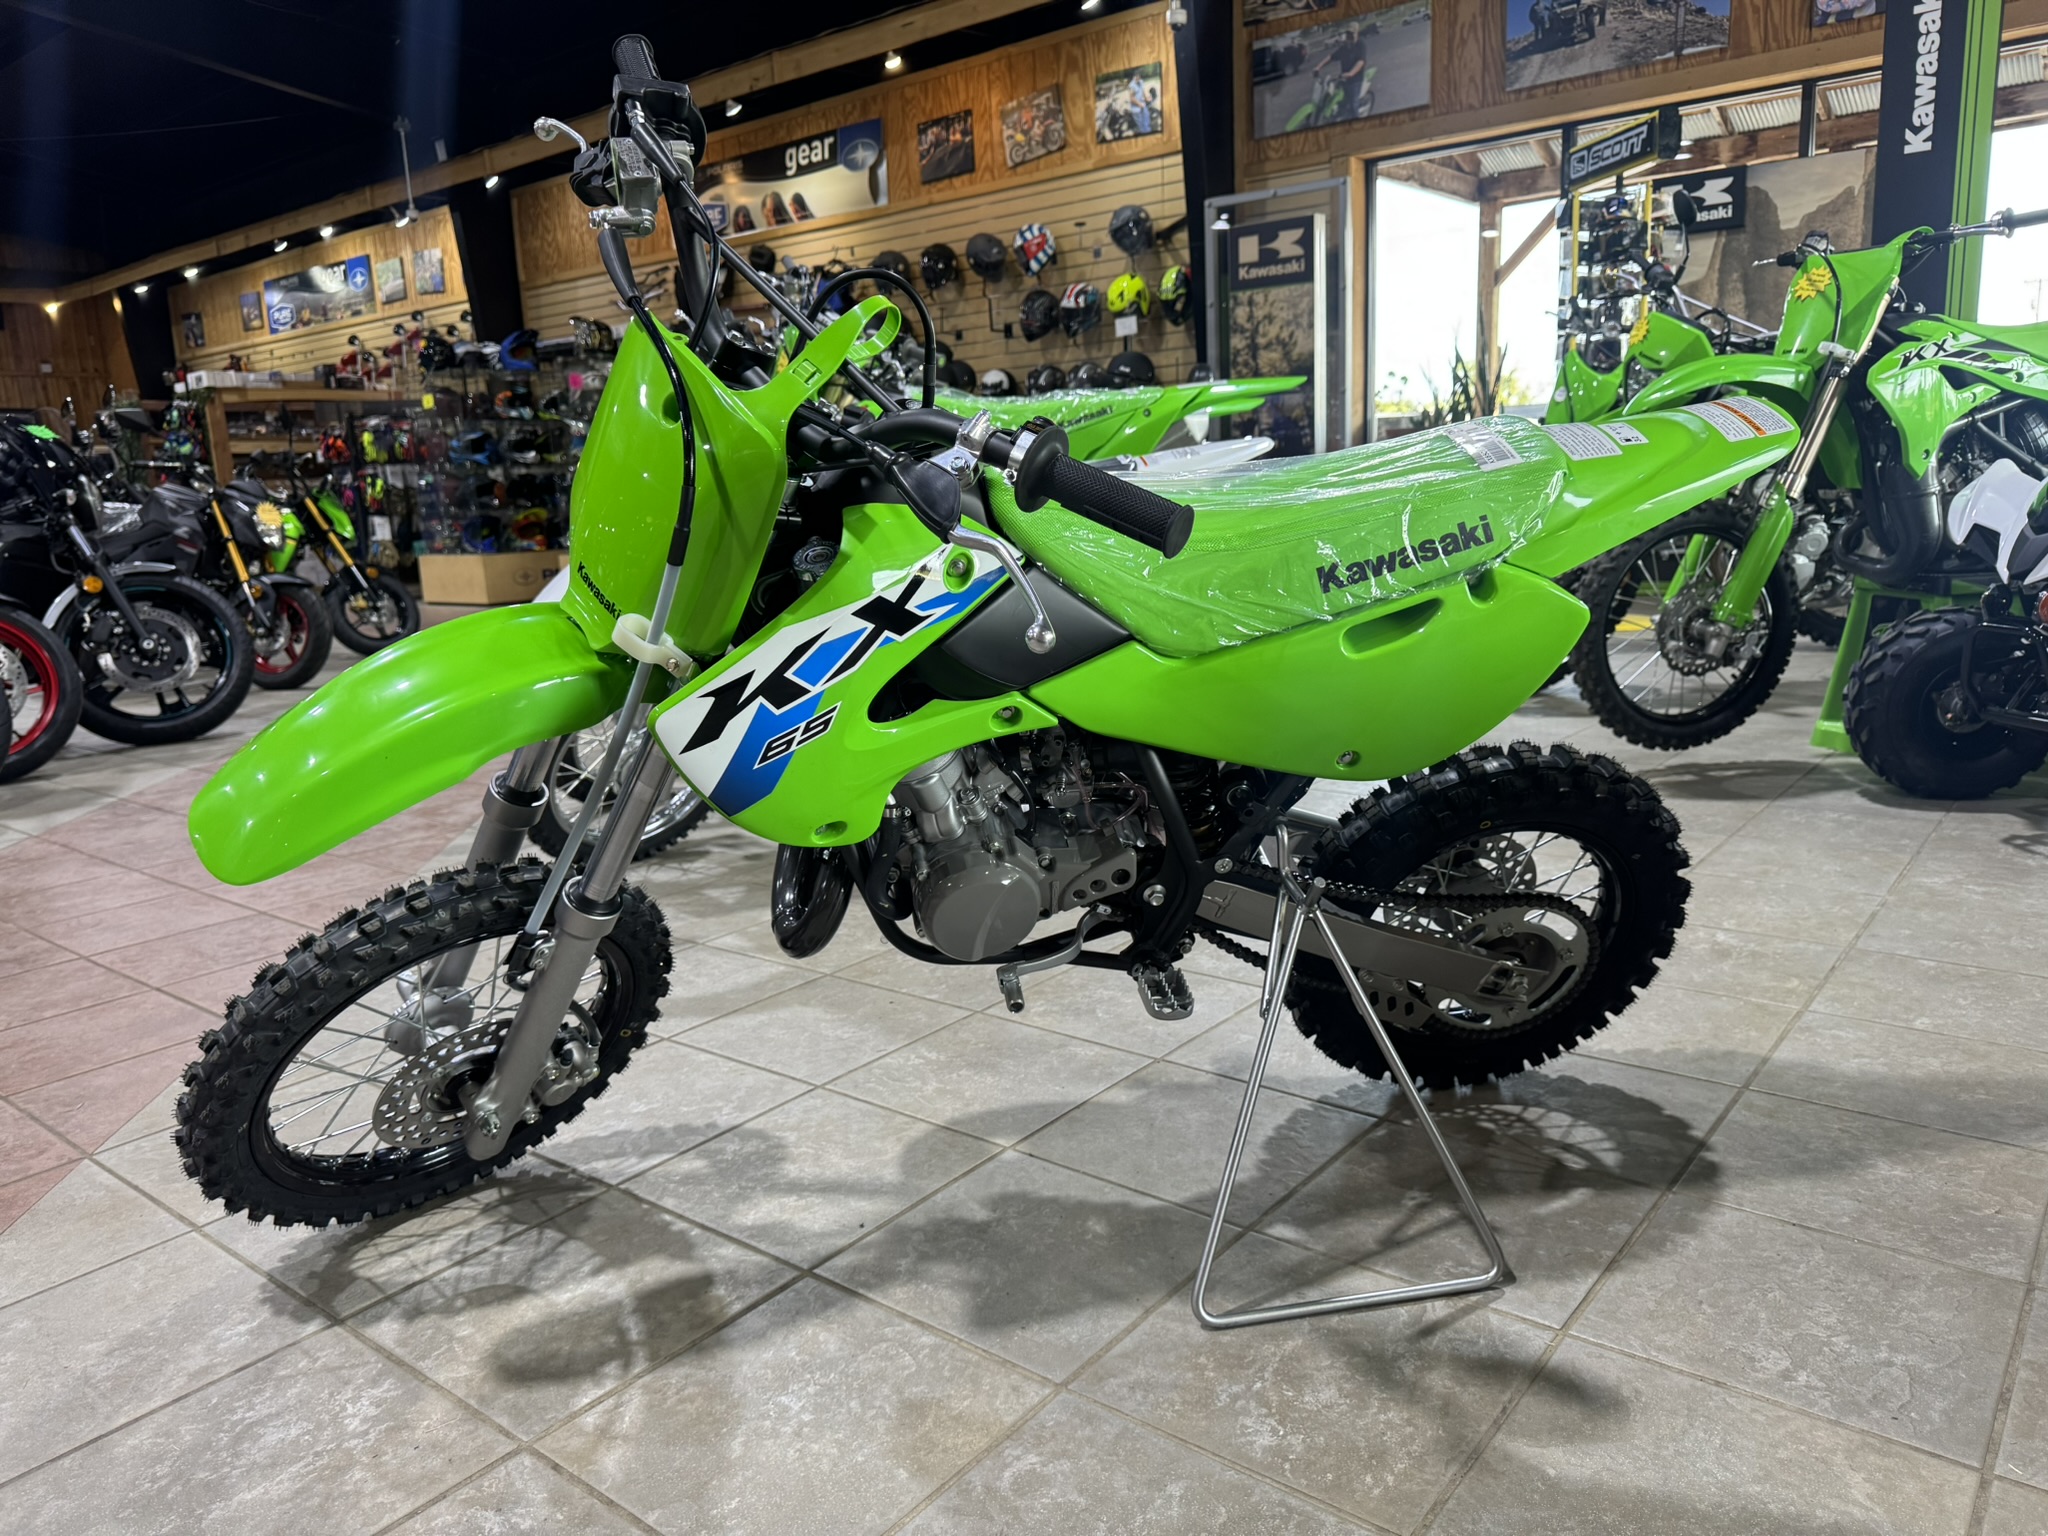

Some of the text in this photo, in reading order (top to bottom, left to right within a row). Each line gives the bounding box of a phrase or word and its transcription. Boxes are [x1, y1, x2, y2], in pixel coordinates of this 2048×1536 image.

[1904, 0, 1942, 154] Kawasak
[785, 136, 834, 177] gear
[1588, 124, 1649, 172] SCOTT
[1696, 204, 1733, 222] saki
[1238, 258, 1305, 280] Kawasaki
[1899, 338, 1950, 370] KX
[1316, 514, 1495, 594] Kawasaki
[577, 560, 623, 621] Kawasaki
[678, 545, 948, 755] KX
[752, 700, 843, 770] 65
